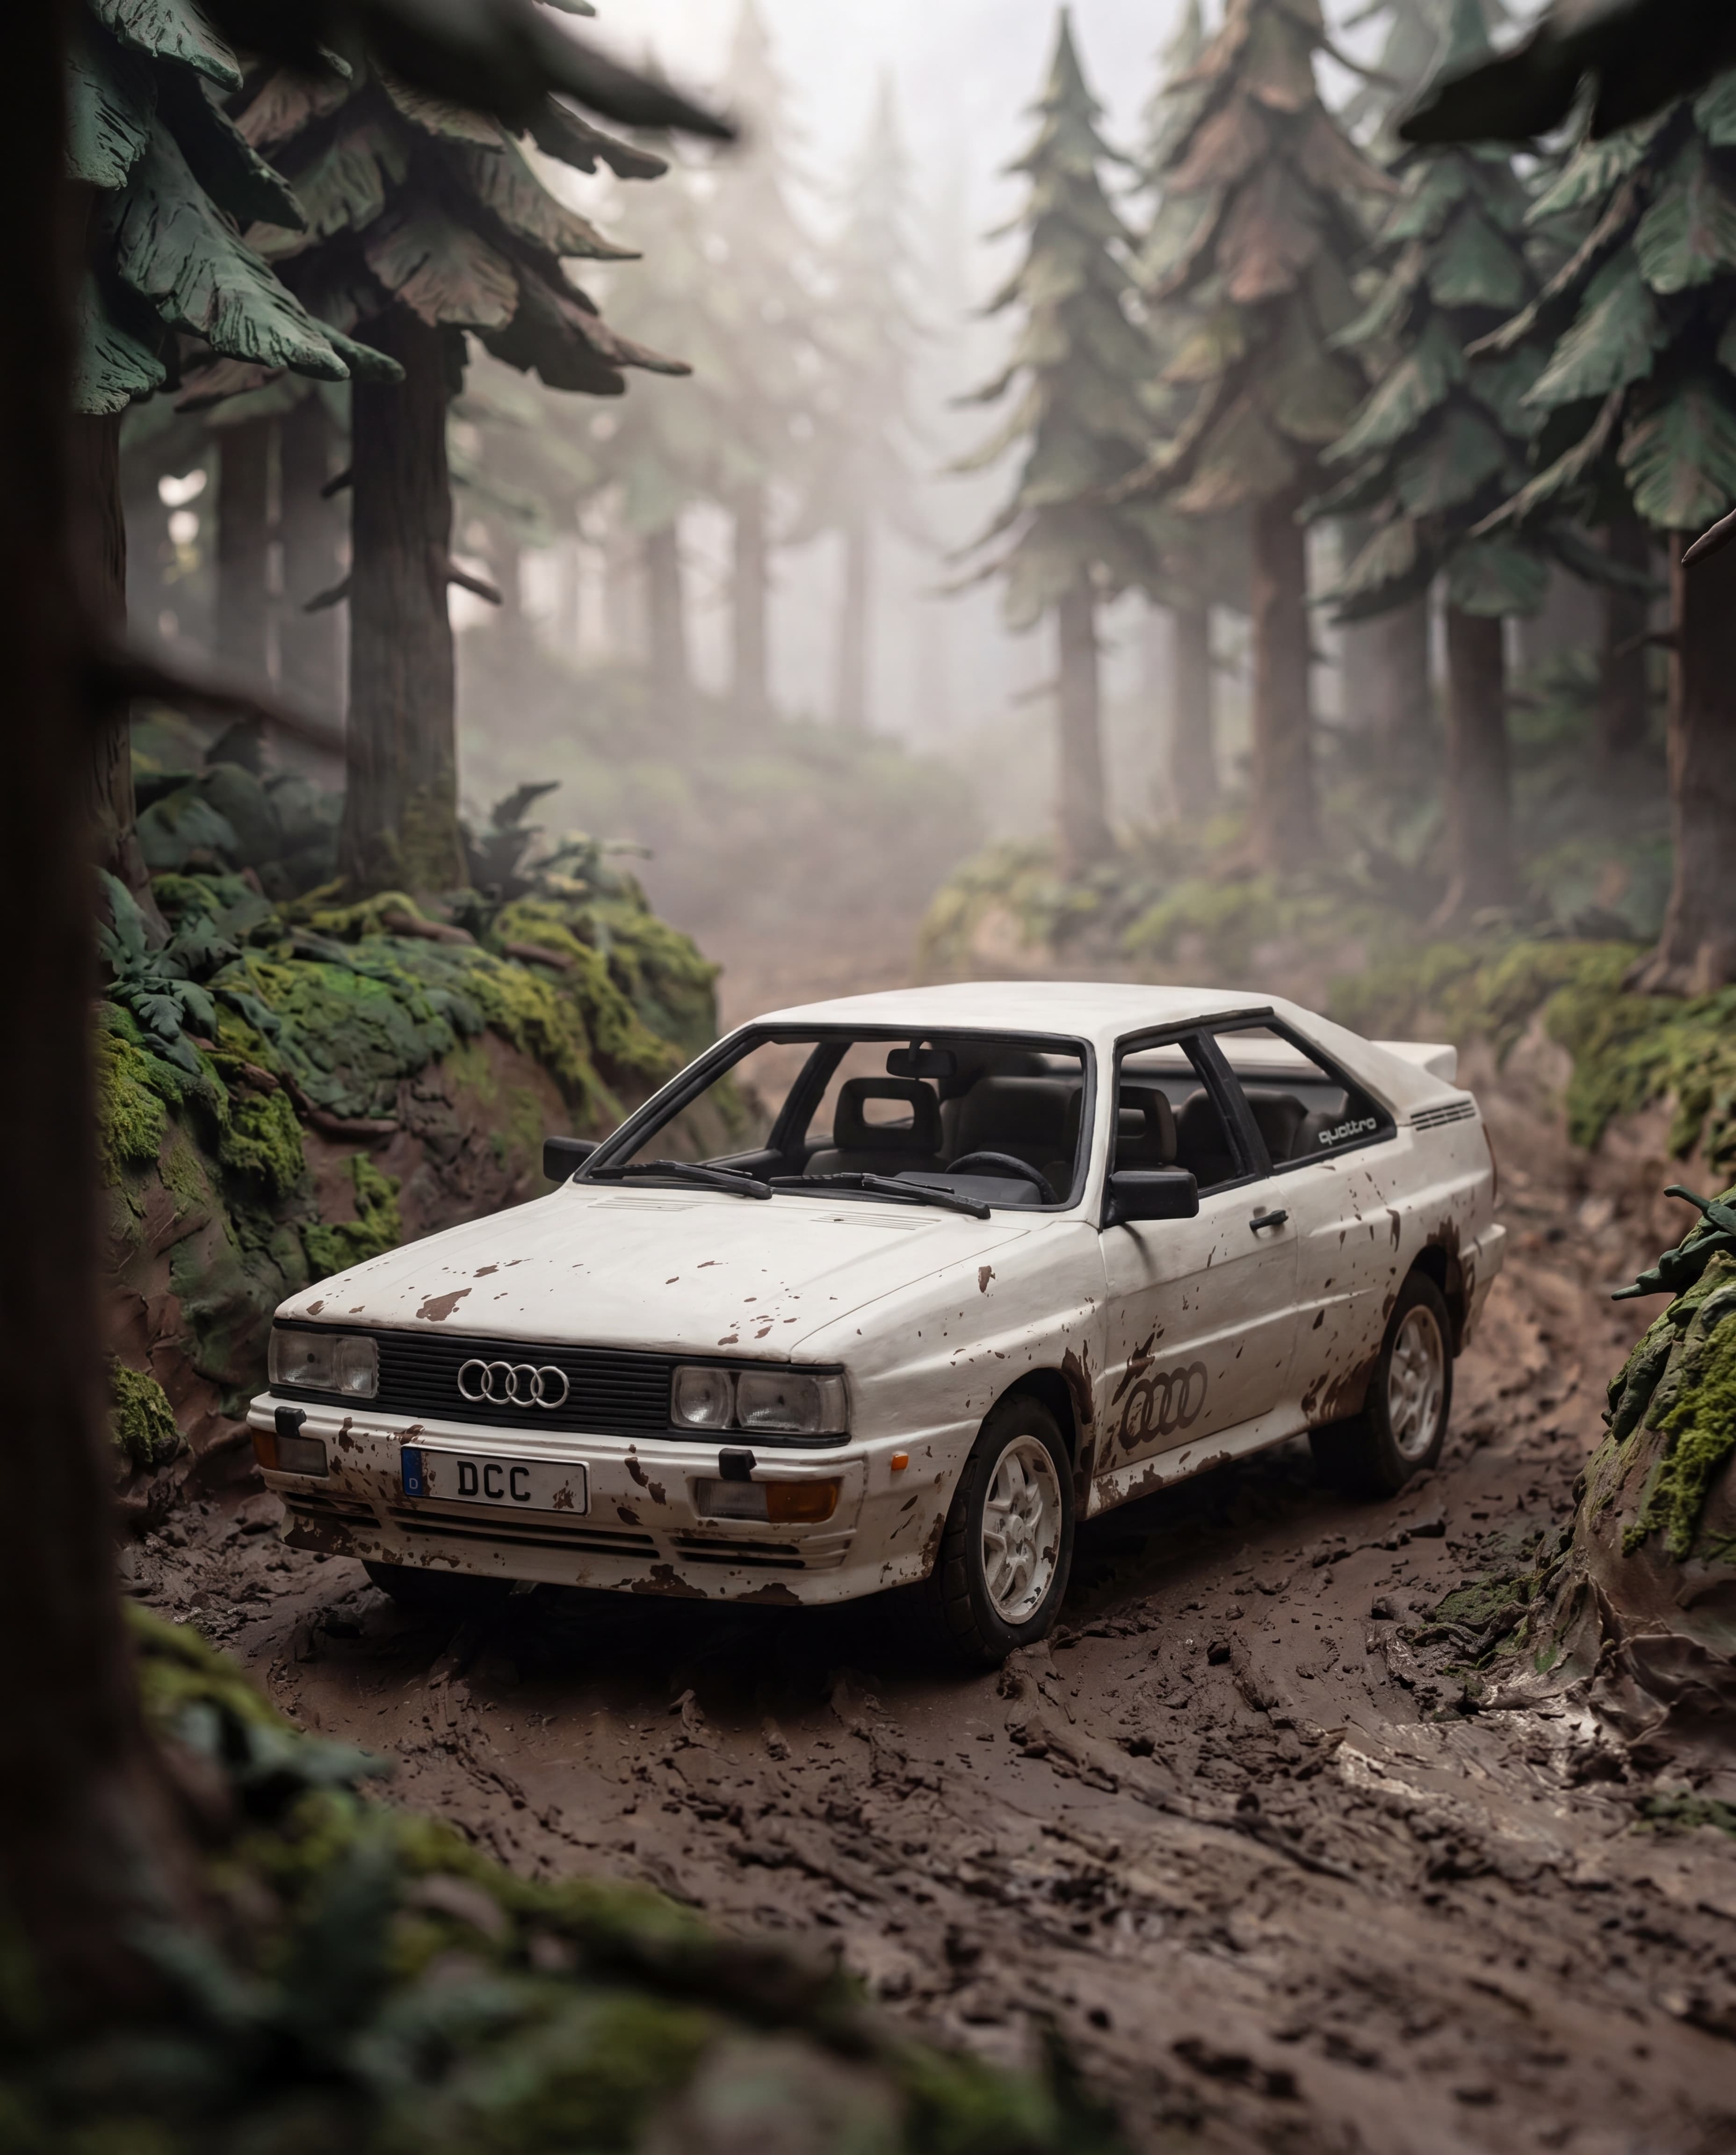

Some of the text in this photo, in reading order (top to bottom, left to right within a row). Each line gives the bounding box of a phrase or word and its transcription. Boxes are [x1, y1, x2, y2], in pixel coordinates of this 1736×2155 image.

[1318, 1117, 1377, 1145] quattro
[409, 1477, 418, 1489] D
[457, 1461, 531, 1501] DCC
